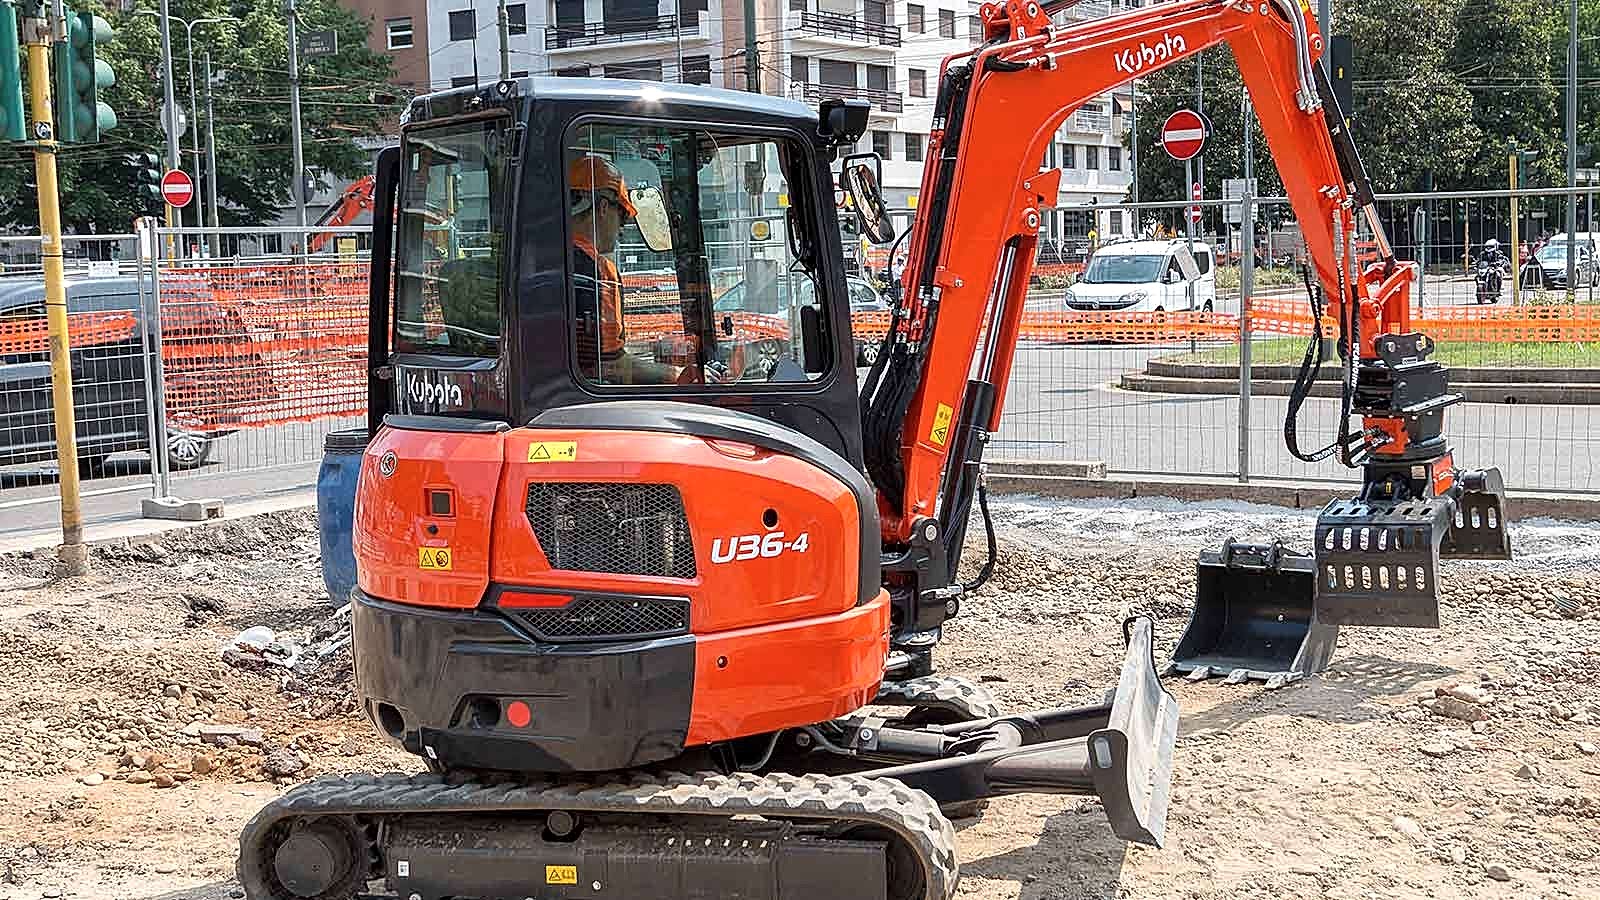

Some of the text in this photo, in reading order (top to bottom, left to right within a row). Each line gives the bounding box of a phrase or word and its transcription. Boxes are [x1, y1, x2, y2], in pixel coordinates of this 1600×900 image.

[1114, 33, 1187, 73] Kubota
[406, 373, 463, 406] Kubota
[711, 531, 809, 564] U36-4
